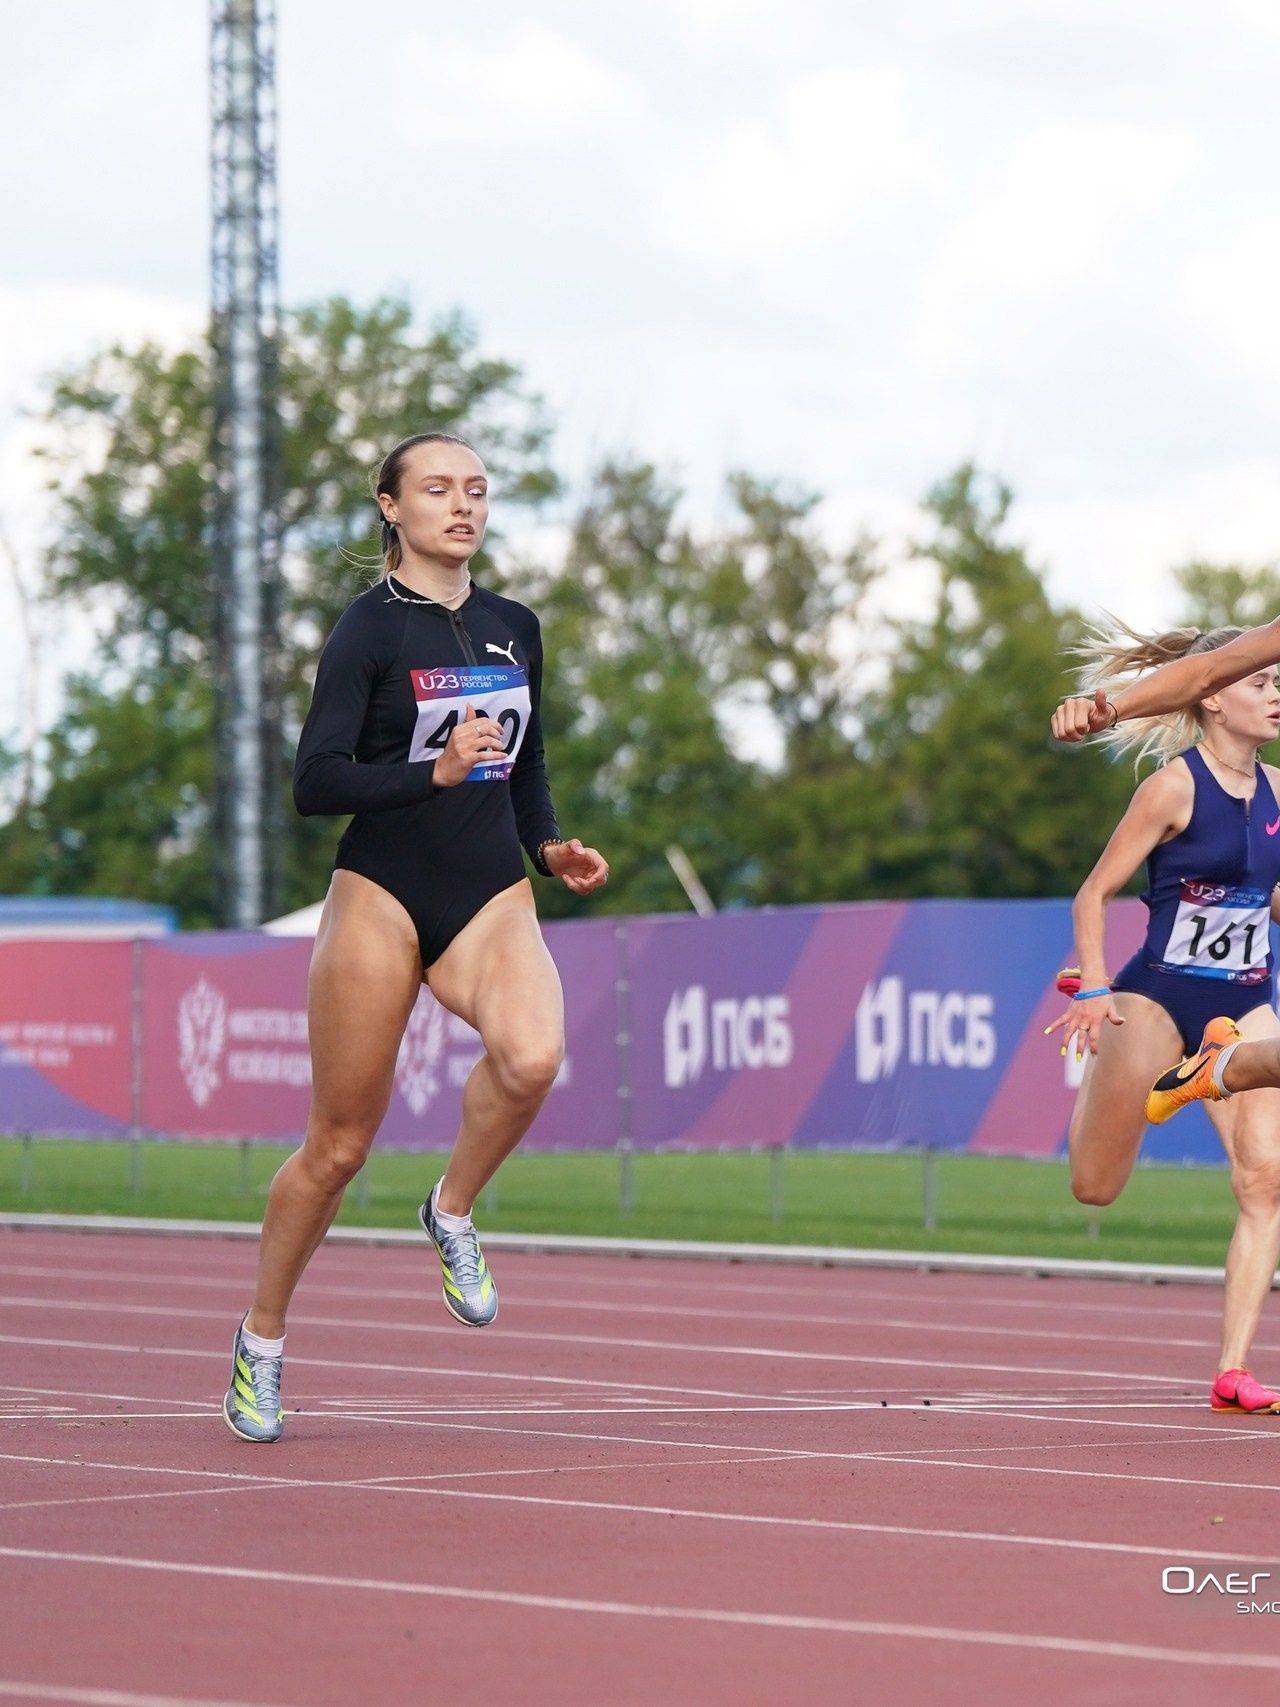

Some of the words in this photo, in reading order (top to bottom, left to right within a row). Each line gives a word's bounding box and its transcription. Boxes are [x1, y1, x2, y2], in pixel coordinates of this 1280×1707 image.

[419, 674, 460, 690] U23
[459, 674, 508, 682] ПЕРВЕНСТВО
[424, 708, 521, 756] 40
[1189, 915, 1257, 965] 161
[711, 994, 793, 1071] ПСБ
[908, 990, 997, 1070] ПСБ
